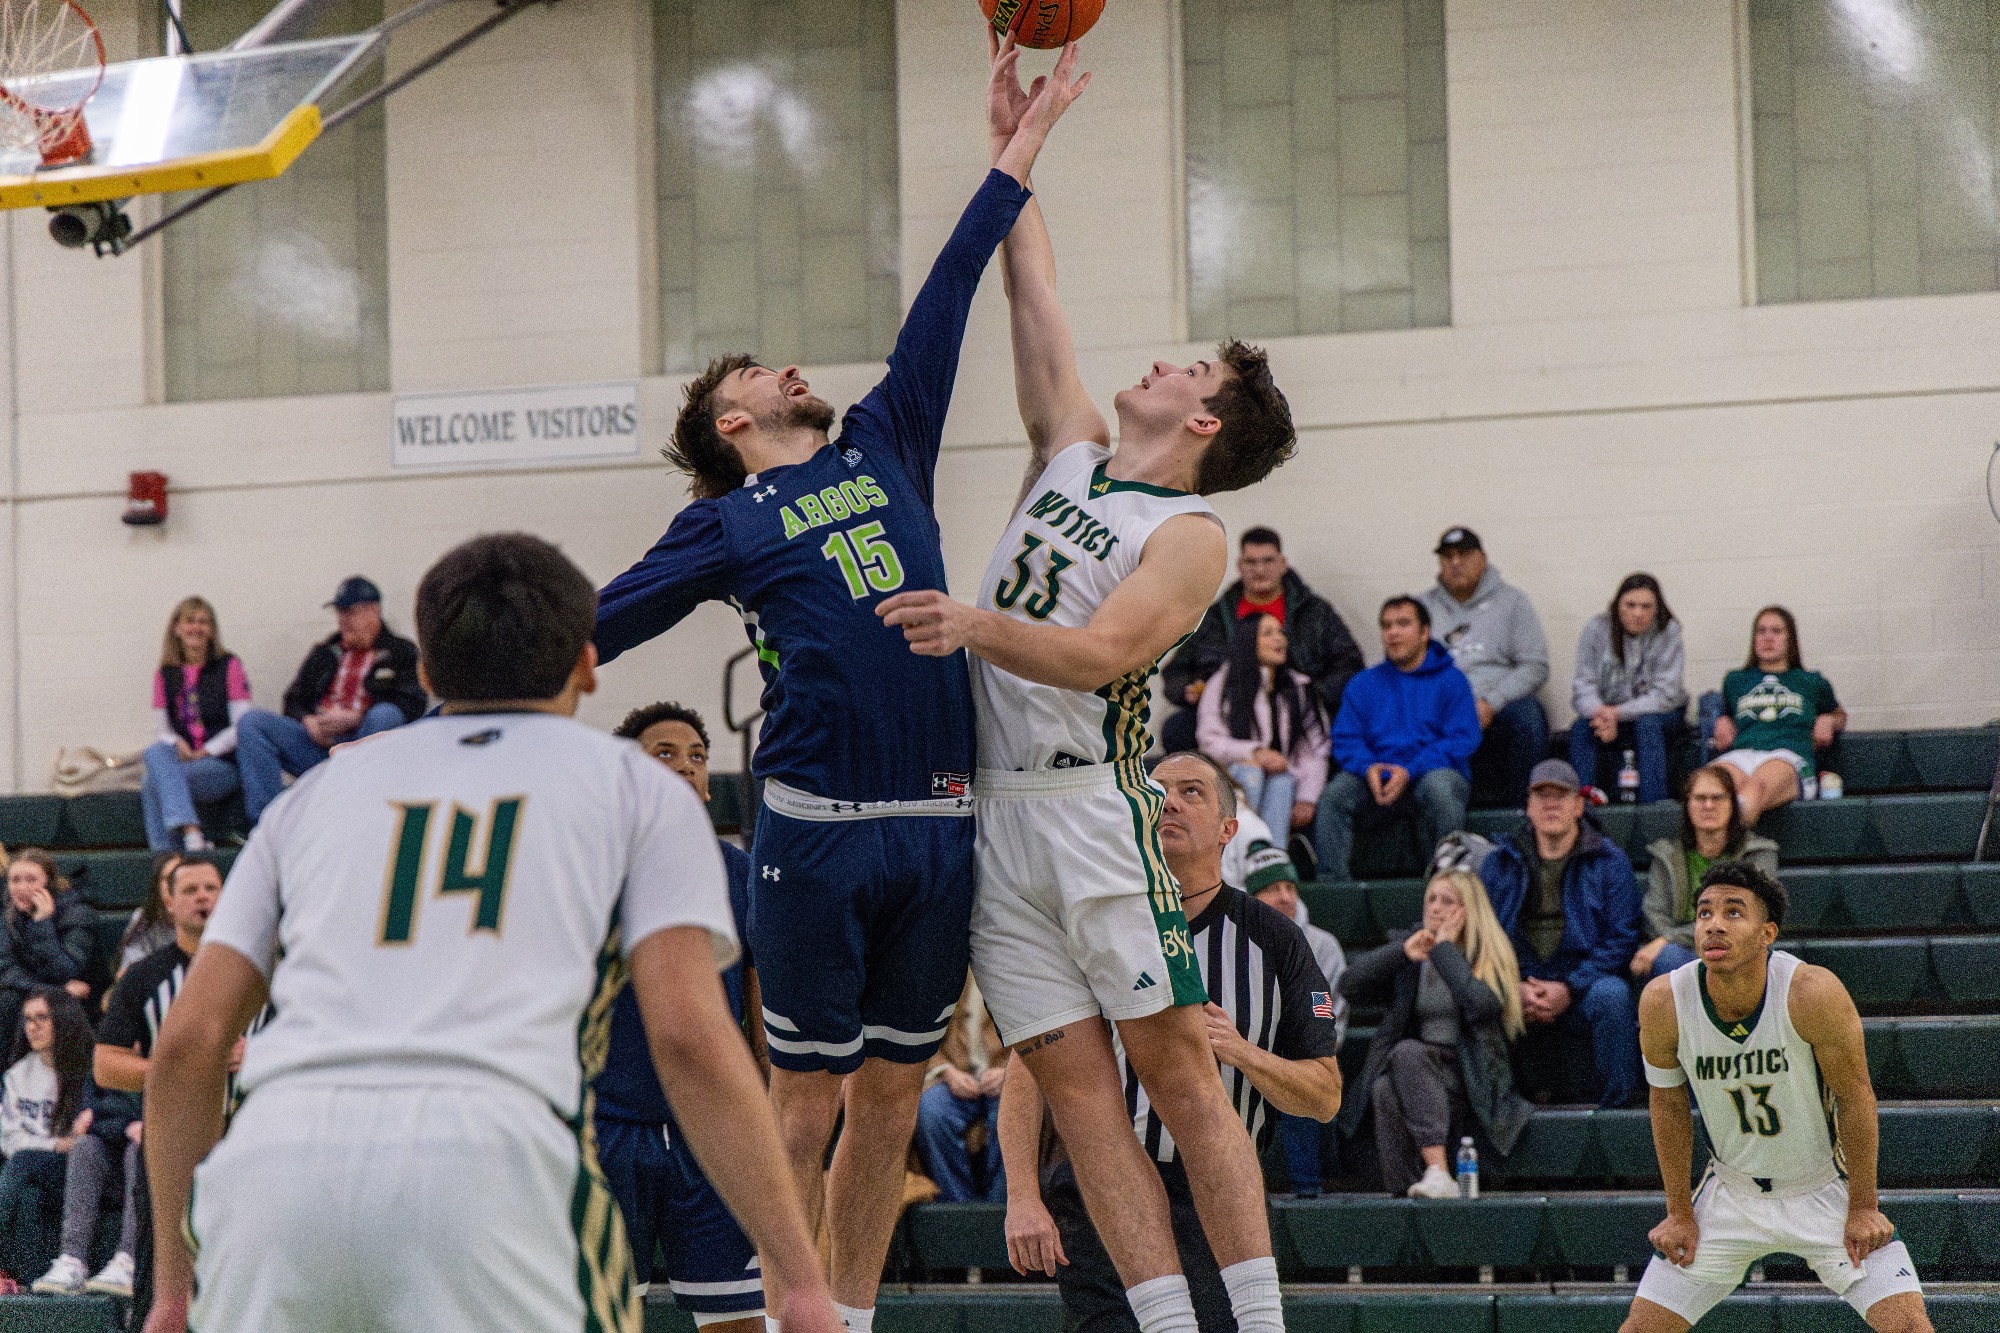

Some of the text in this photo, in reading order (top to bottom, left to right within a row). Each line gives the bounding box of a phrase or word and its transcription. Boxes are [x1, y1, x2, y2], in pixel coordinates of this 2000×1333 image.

[397, 403, 637, 447] WELCOME VISITORS
[779, 475, 888, 540] ARGOS
[1026, 489, 1119, 562] MYSTICS
[820, 519, 905, 600] 15
[993, 530, 1078, 622] 33
[373, 793, 530, 949] 14
[1722, 1083, 1783, 1138] 13
